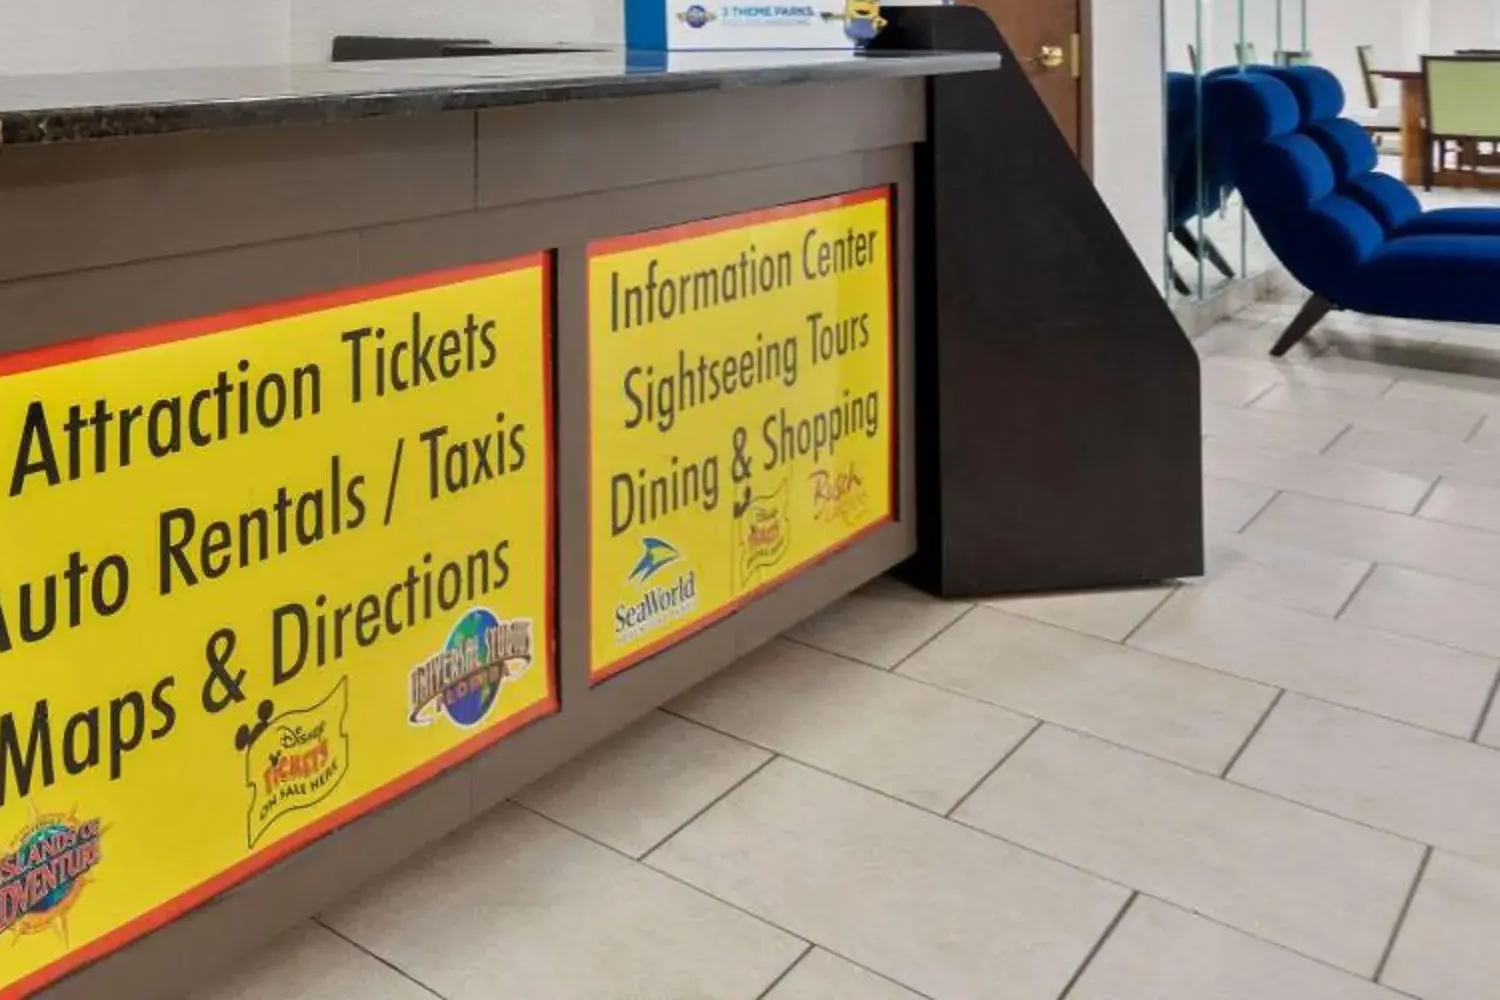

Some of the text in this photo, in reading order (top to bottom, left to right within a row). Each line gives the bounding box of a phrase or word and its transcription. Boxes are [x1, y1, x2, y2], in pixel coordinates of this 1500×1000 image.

[733, 6, 773, 17] THEME
[611, 228, 877, 332] Information Center
[9, 312, 498, 498] Attraction Tickets
[624, 312, 869, 433] Sightseeing Tours
[158, 455, 366, 596] Rentals
[383, 437, 404, 526] /
[419, 412, 526, 501] Taxis
[611, 454, 719, 537] Dining
[731, 426, 752, 483] &
[763, 390, 879, 471] Shopping
[201, 627, 247, 714] &
[271, 538, 510, 687] Directions
[615, 571, 697, 633] SeaWorld
[411, 620, 531, 706] UNIVERSAL STUDIOS
[260, 759, 338, 821] ON SALE HERE
[264, 738, 329, 794] TICKETS
